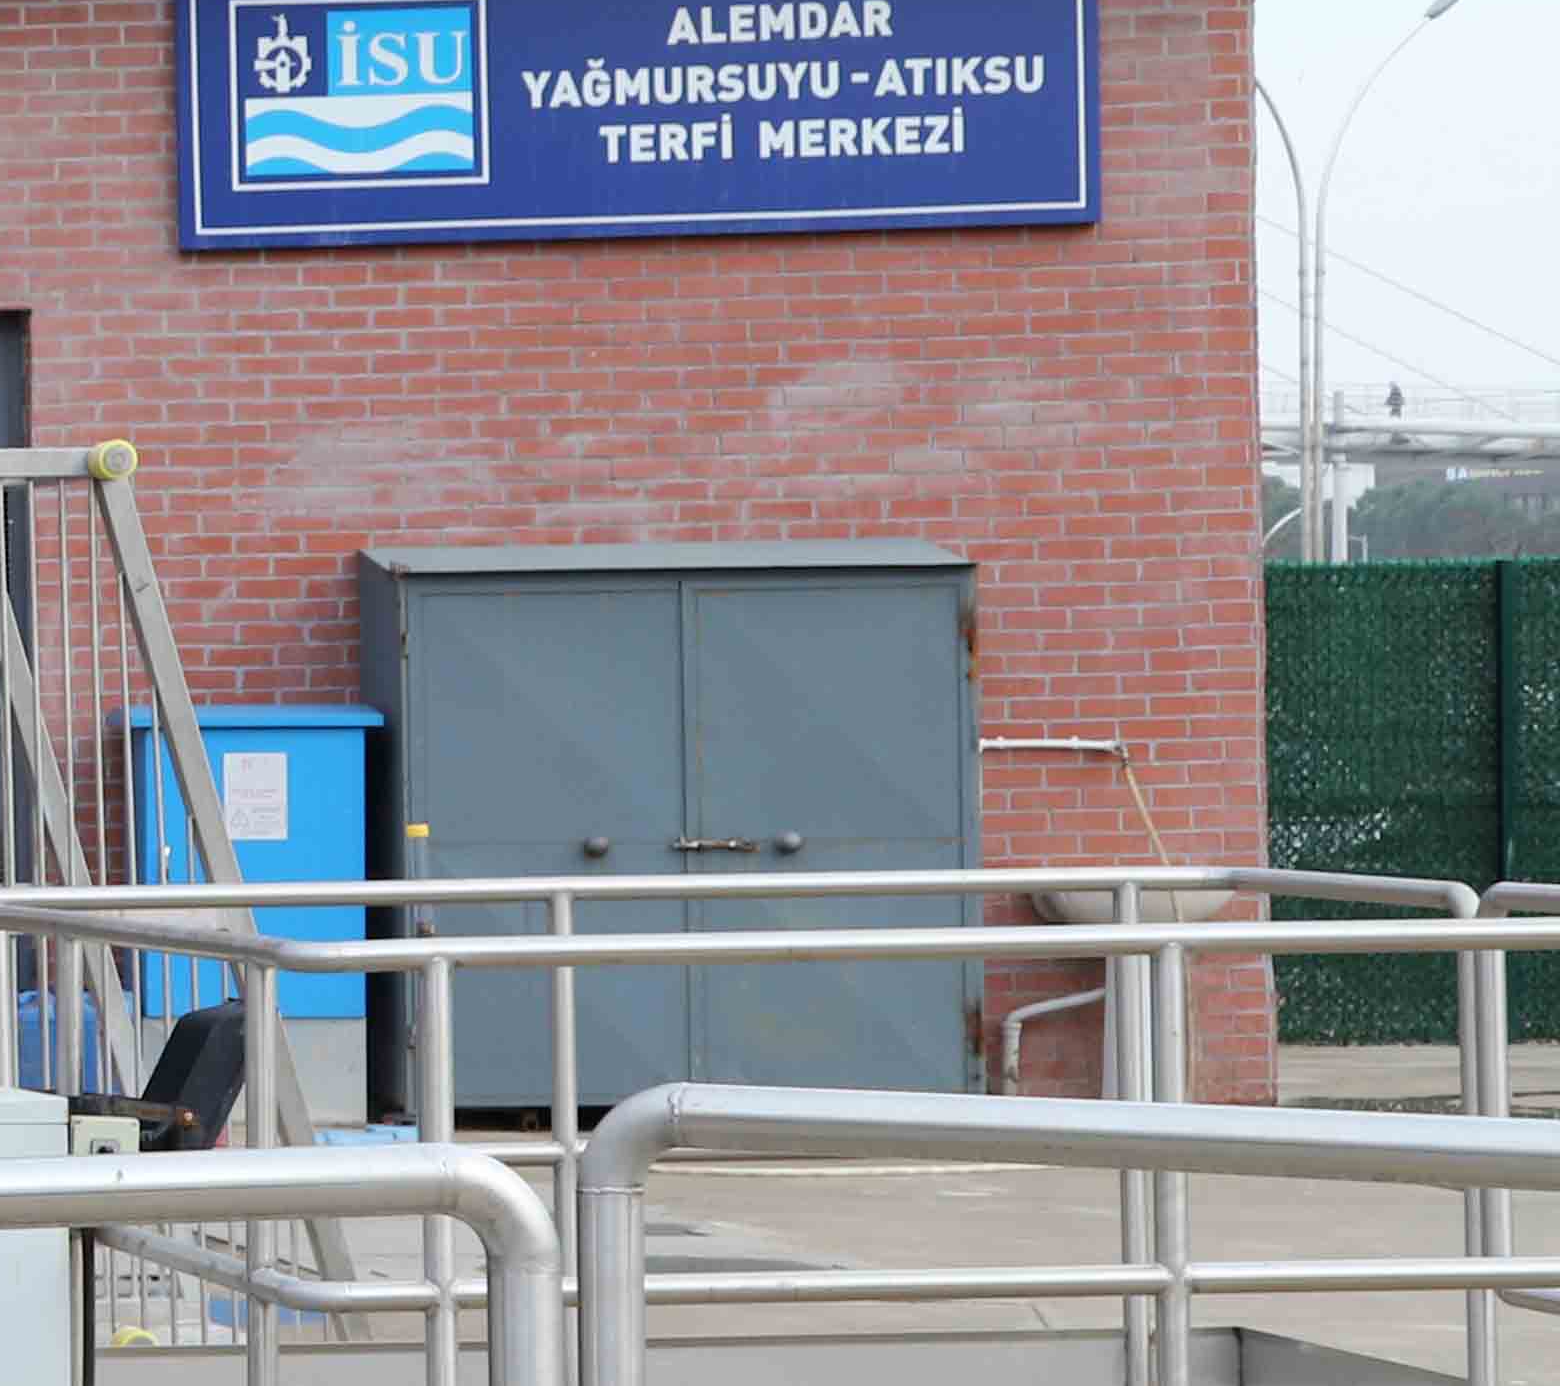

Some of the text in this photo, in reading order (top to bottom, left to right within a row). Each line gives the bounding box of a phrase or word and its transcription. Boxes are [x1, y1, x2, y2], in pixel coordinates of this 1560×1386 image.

[666, 0, 893, 46] ALEMDAR
[336, 20, 469, 87] İSU
[599, 107, 965, 163] TERFİ MERKEZİ
